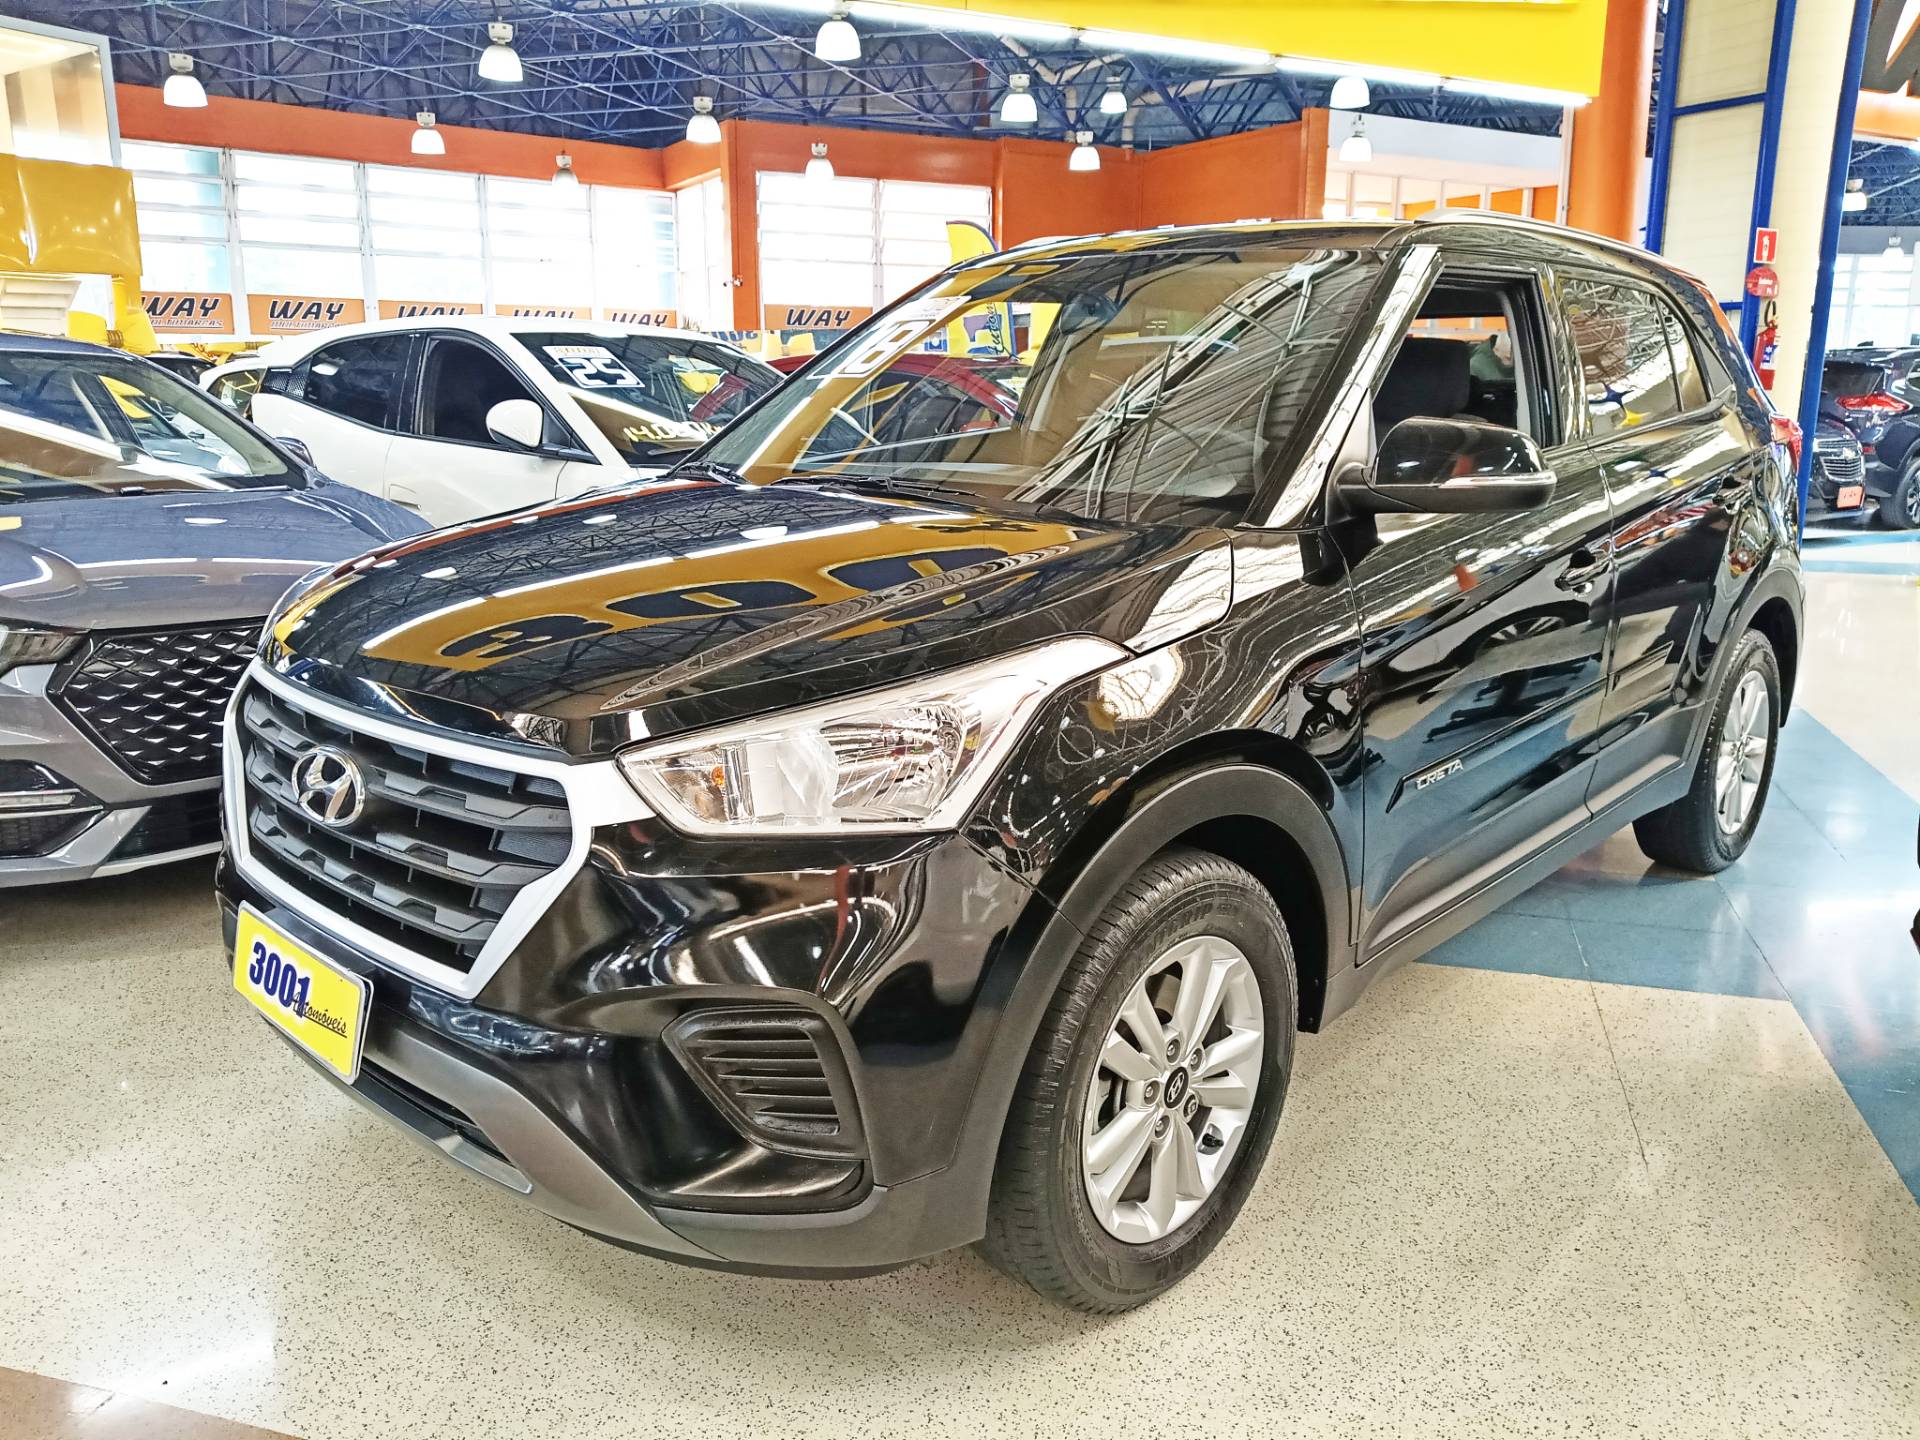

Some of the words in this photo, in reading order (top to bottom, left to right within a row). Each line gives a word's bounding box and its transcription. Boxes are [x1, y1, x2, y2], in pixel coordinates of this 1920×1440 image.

[140, 296, 220, 317] WAY
[269, 300, 345, 320] WAY
[786, 308, 850, 327] WAY
[562, 357, 641, 386] 25
[1416, 759, 1464, 790] CRETA
[249, 941, 311, 1018] 3001
